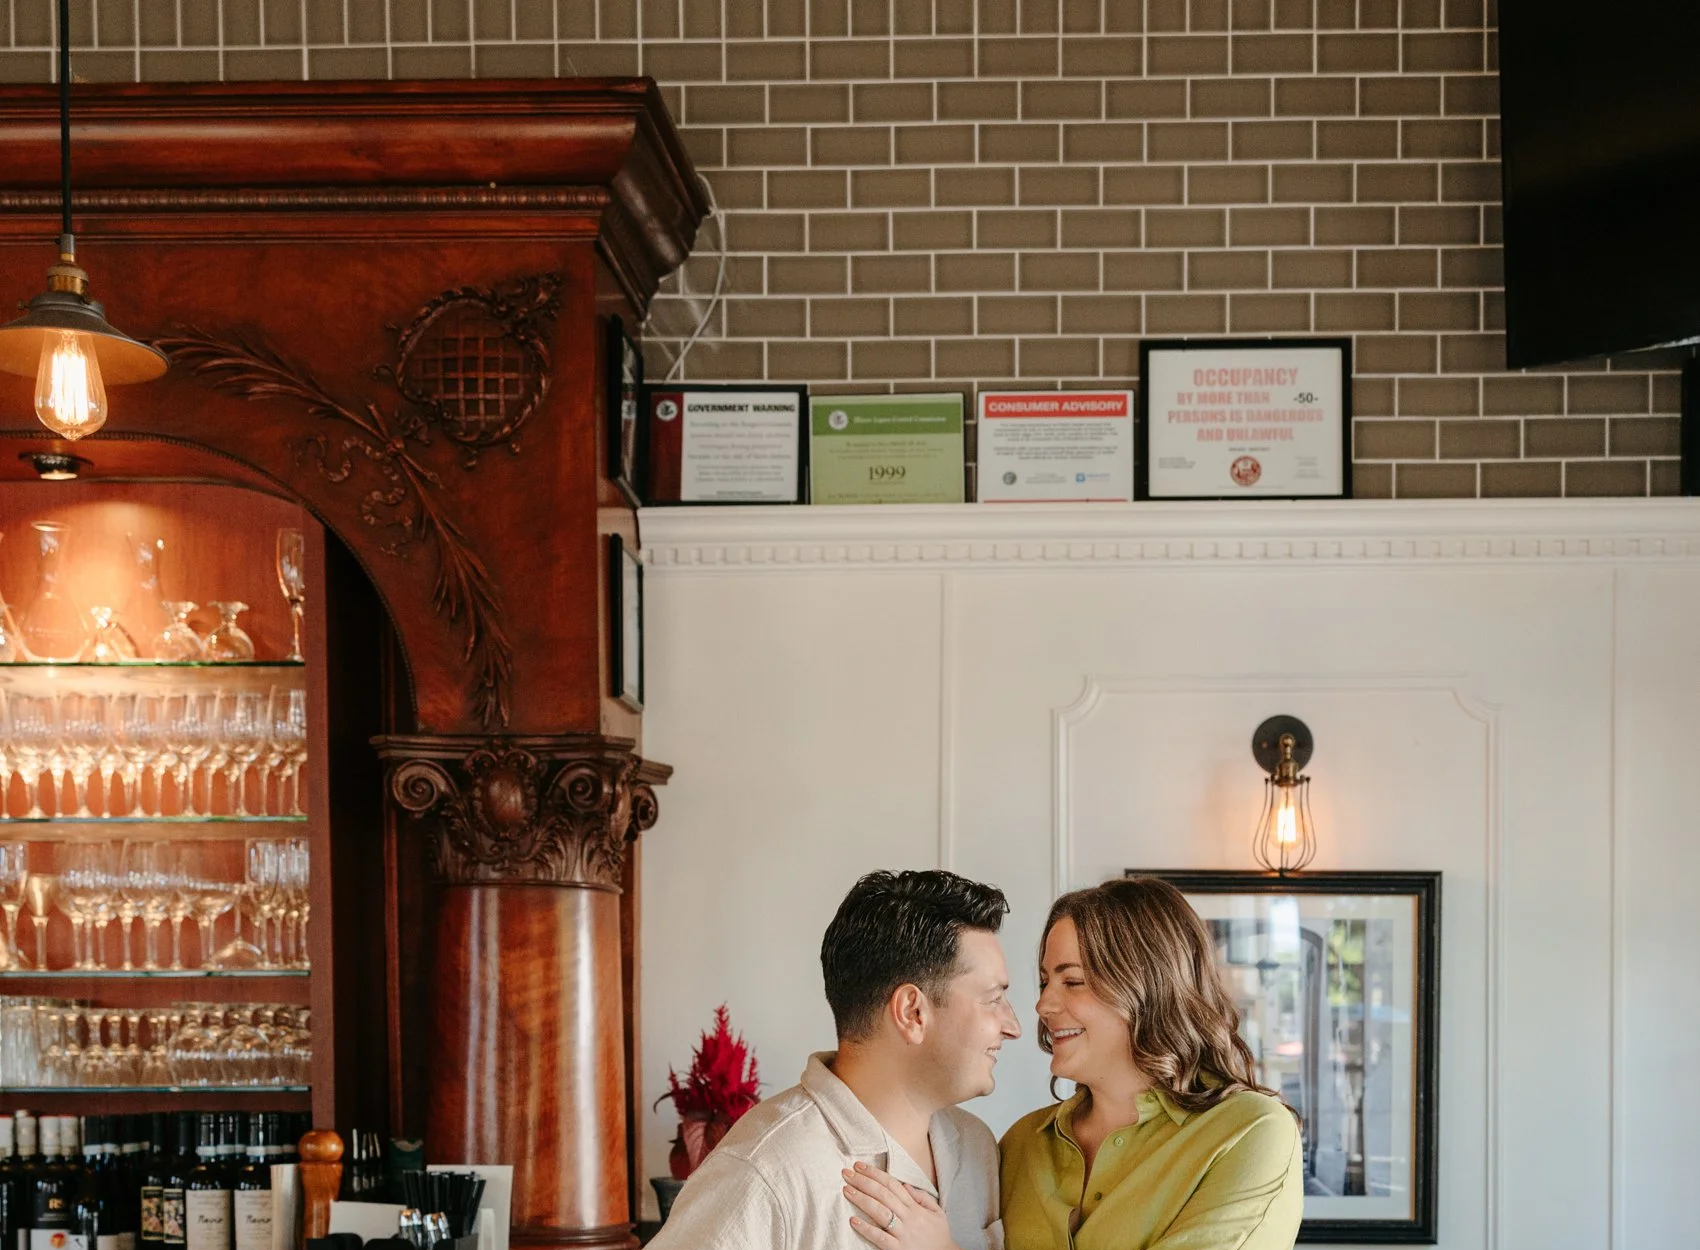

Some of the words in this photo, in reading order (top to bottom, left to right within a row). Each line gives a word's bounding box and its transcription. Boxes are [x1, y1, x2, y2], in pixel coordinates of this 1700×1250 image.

[1193, 367, 1299, 387] OCCUPANCY
[1177, 391, 1193, 405] BY
[1197, 391, 1233, 405] MORE
[1237, 391, 1270, 404] THAN
[687, 403, 749, 413] GOVERNMENT
[752, 403, 796, 412] WARNING
[988, 401, 1059, 413] CONSUMER
[1062, 400, 1124, 412] ADVISORY
[1168, 409, 1227, 424] PERSONS
[1230, 409, 1243, 422] IS
[1247, 408, 1324, 422] DANGEROUS
[1197, 428, 1223, 442] AND
[1227, 427, 1294, 441] UNLAWFUL
[868, 464, 907, 481] 1999
